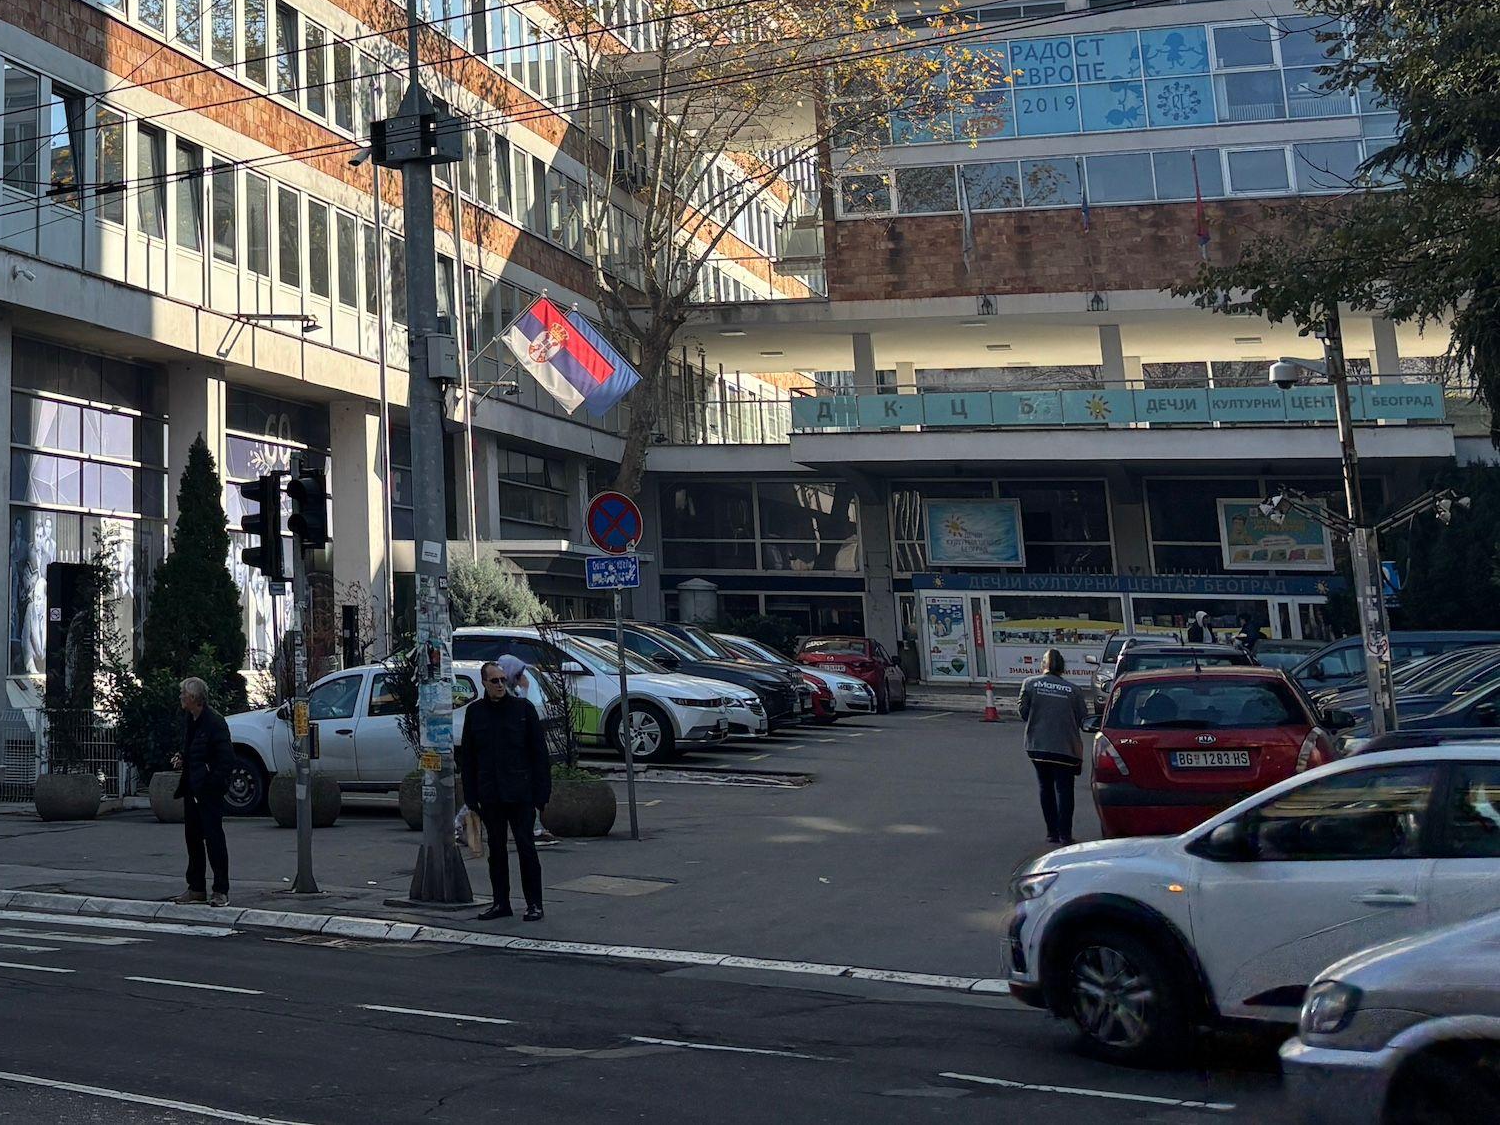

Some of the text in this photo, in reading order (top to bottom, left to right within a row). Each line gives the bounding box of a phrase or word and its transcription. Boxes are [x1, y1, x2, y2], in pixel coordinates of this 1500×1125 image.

[1011, 39, 1105, 64] РАДОСТ
[1022, 94, 1076, 115] 2019
[884, 401, 898, 417] К
[951, 399, 968, 419] Ц
[1146, 398, 1198, 415] ДЕЧЈИ
[1212, 397, 1282, 411] КУЛТУРНИ
[1291, 394, 1357, 411] ЦЕНТР
[1372, 394, 1435, 408] БЕОГРАД
[968, 576, 1287, 593] ДЕЧЈИ КУЛТУРНИ ЦЕНТАР БЕОГРАД
[1179, 752, 1248, 765] BG 1283 HS
